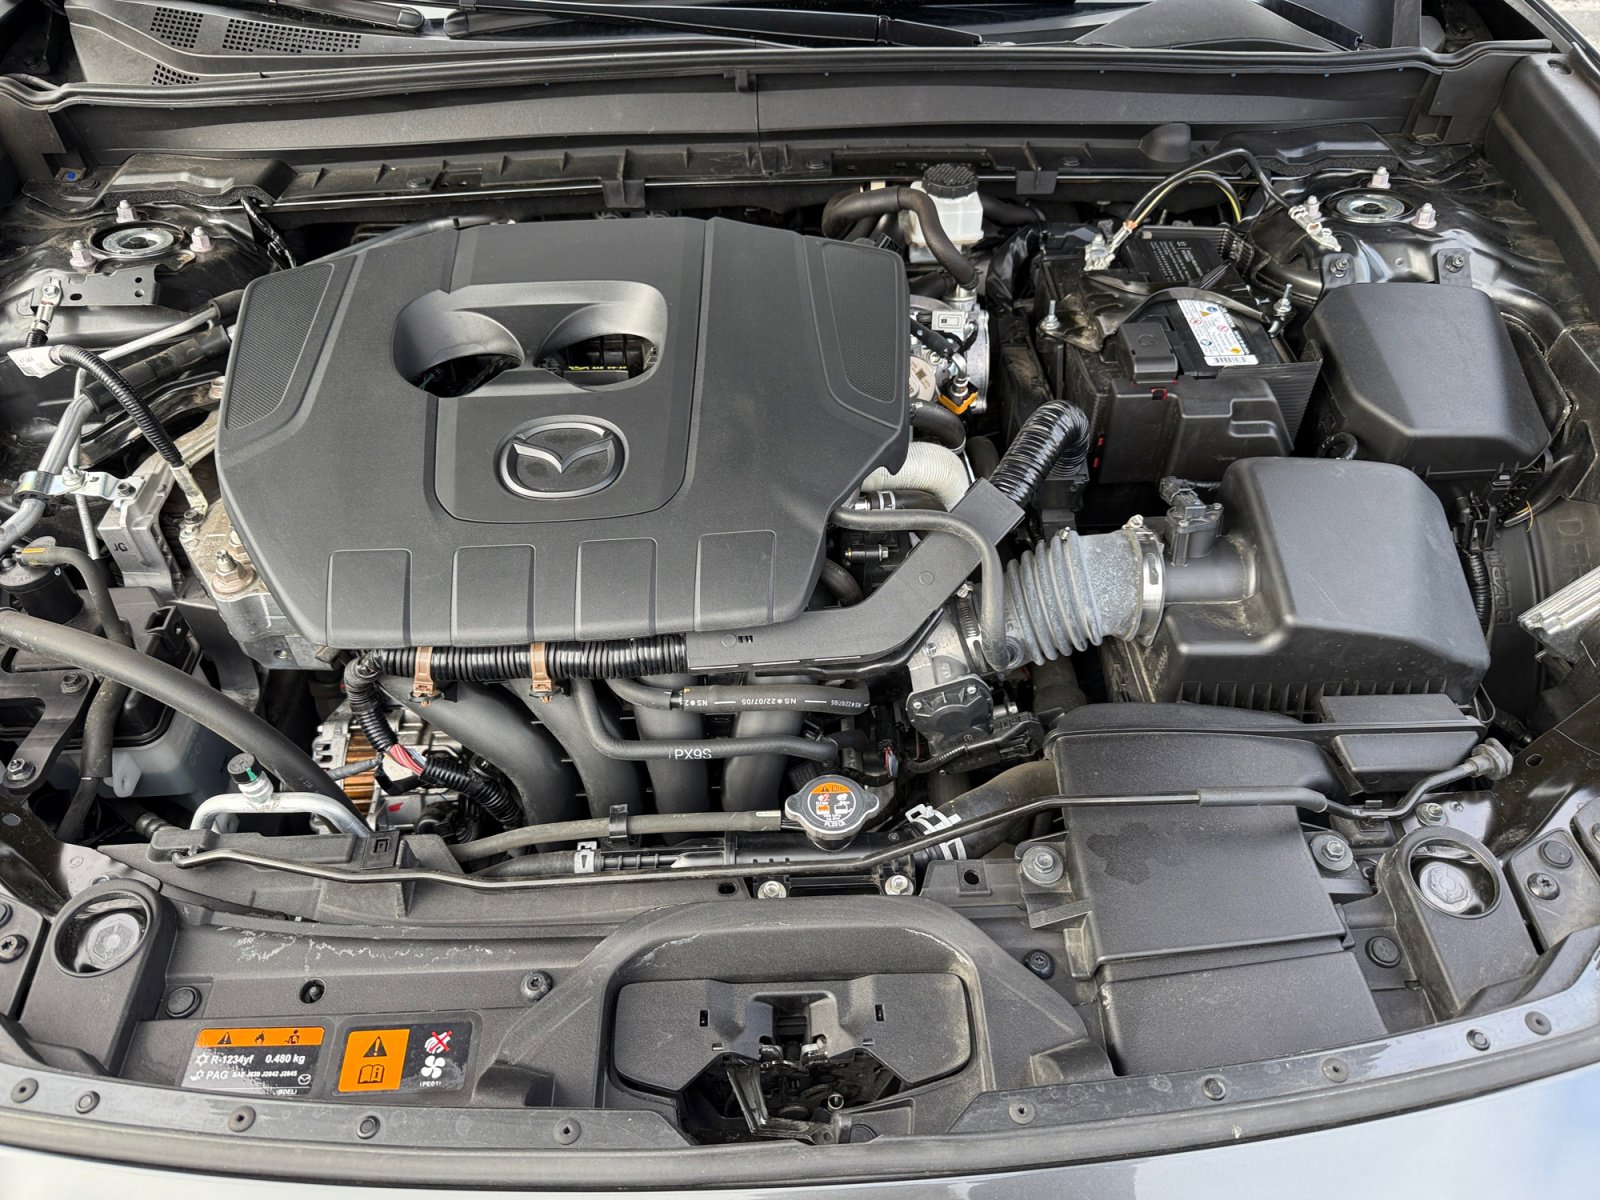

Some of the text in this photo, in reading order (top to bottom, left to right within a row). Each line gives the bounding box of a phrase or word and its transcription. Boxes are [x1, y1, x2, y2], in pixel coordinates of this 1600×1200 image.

[674, 748, 713, 760] PX9S
[210, 1053, 306, 1066] R-1234yf 0.480 kg
[206, 1070, 229, 1080] PAG
